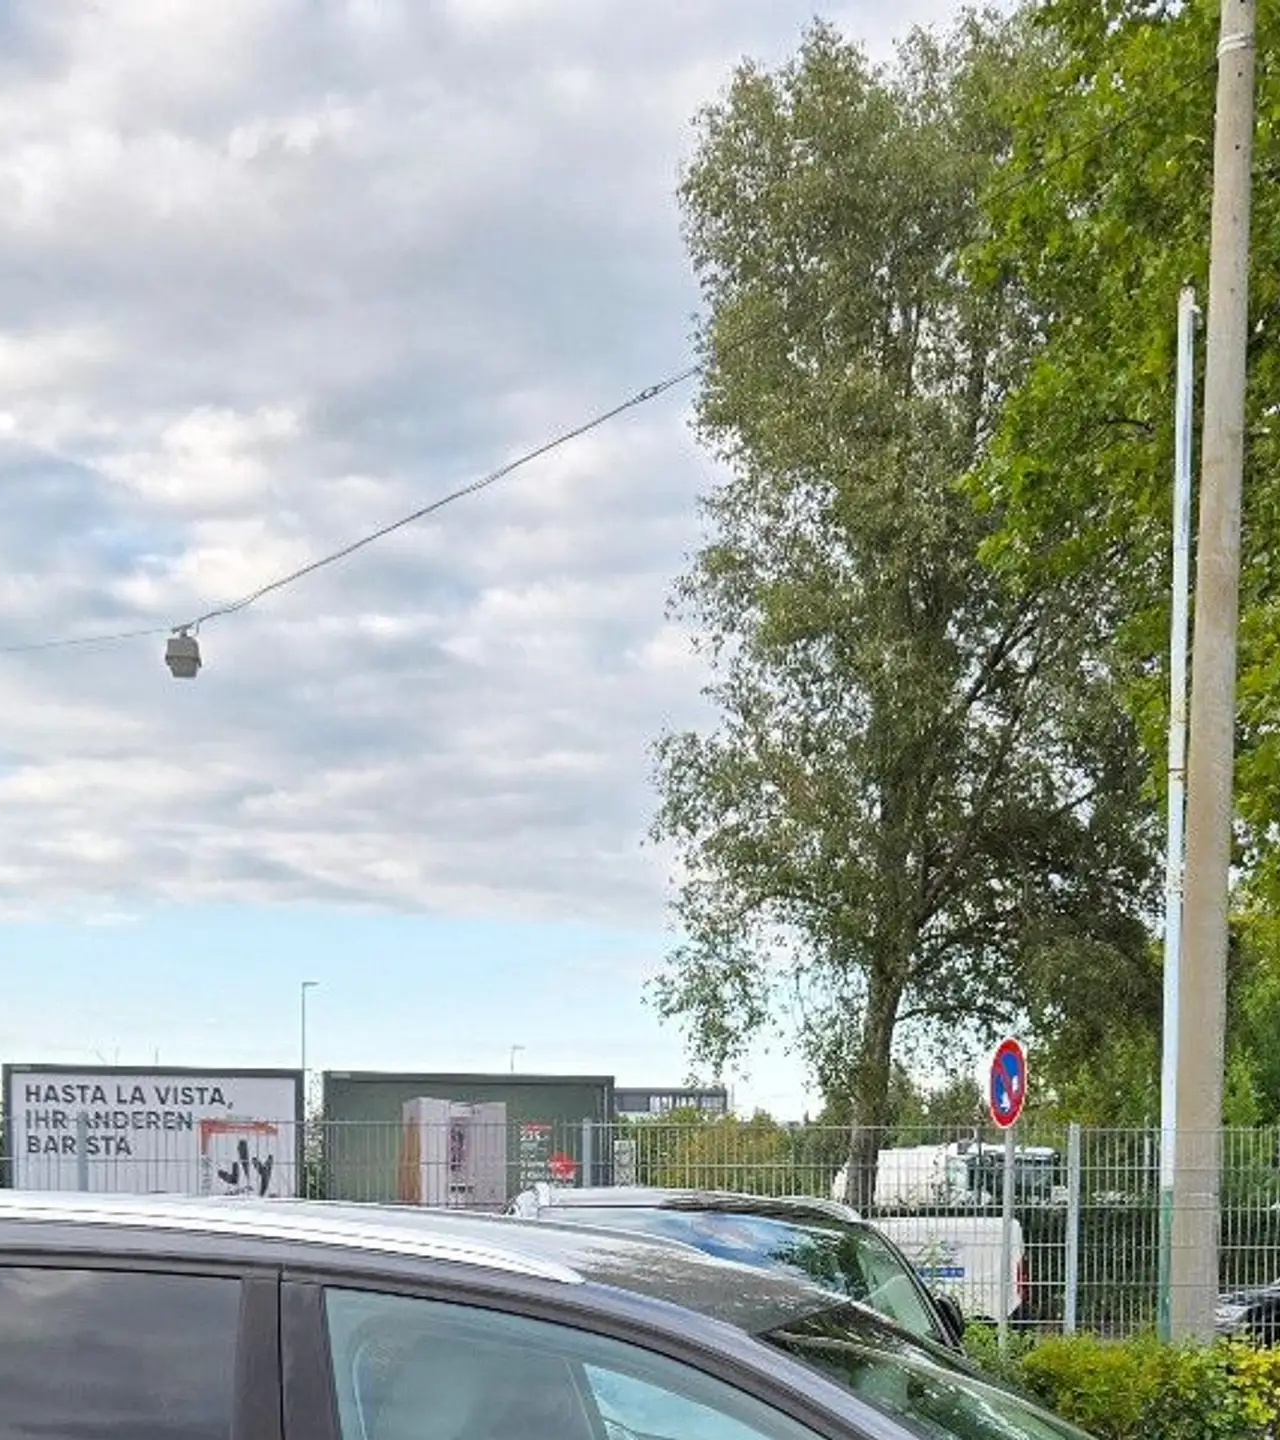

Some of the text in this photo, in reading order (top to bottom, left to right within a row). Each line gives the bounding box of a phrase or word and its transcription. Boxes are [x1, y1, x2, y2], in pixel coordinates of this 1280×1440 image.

[25, 1084, 234, 1110] HASTA LA VISTA,
[25, 1109, 67, 1129] IHR
[27, 1135, 132, 1155] BARSTA
